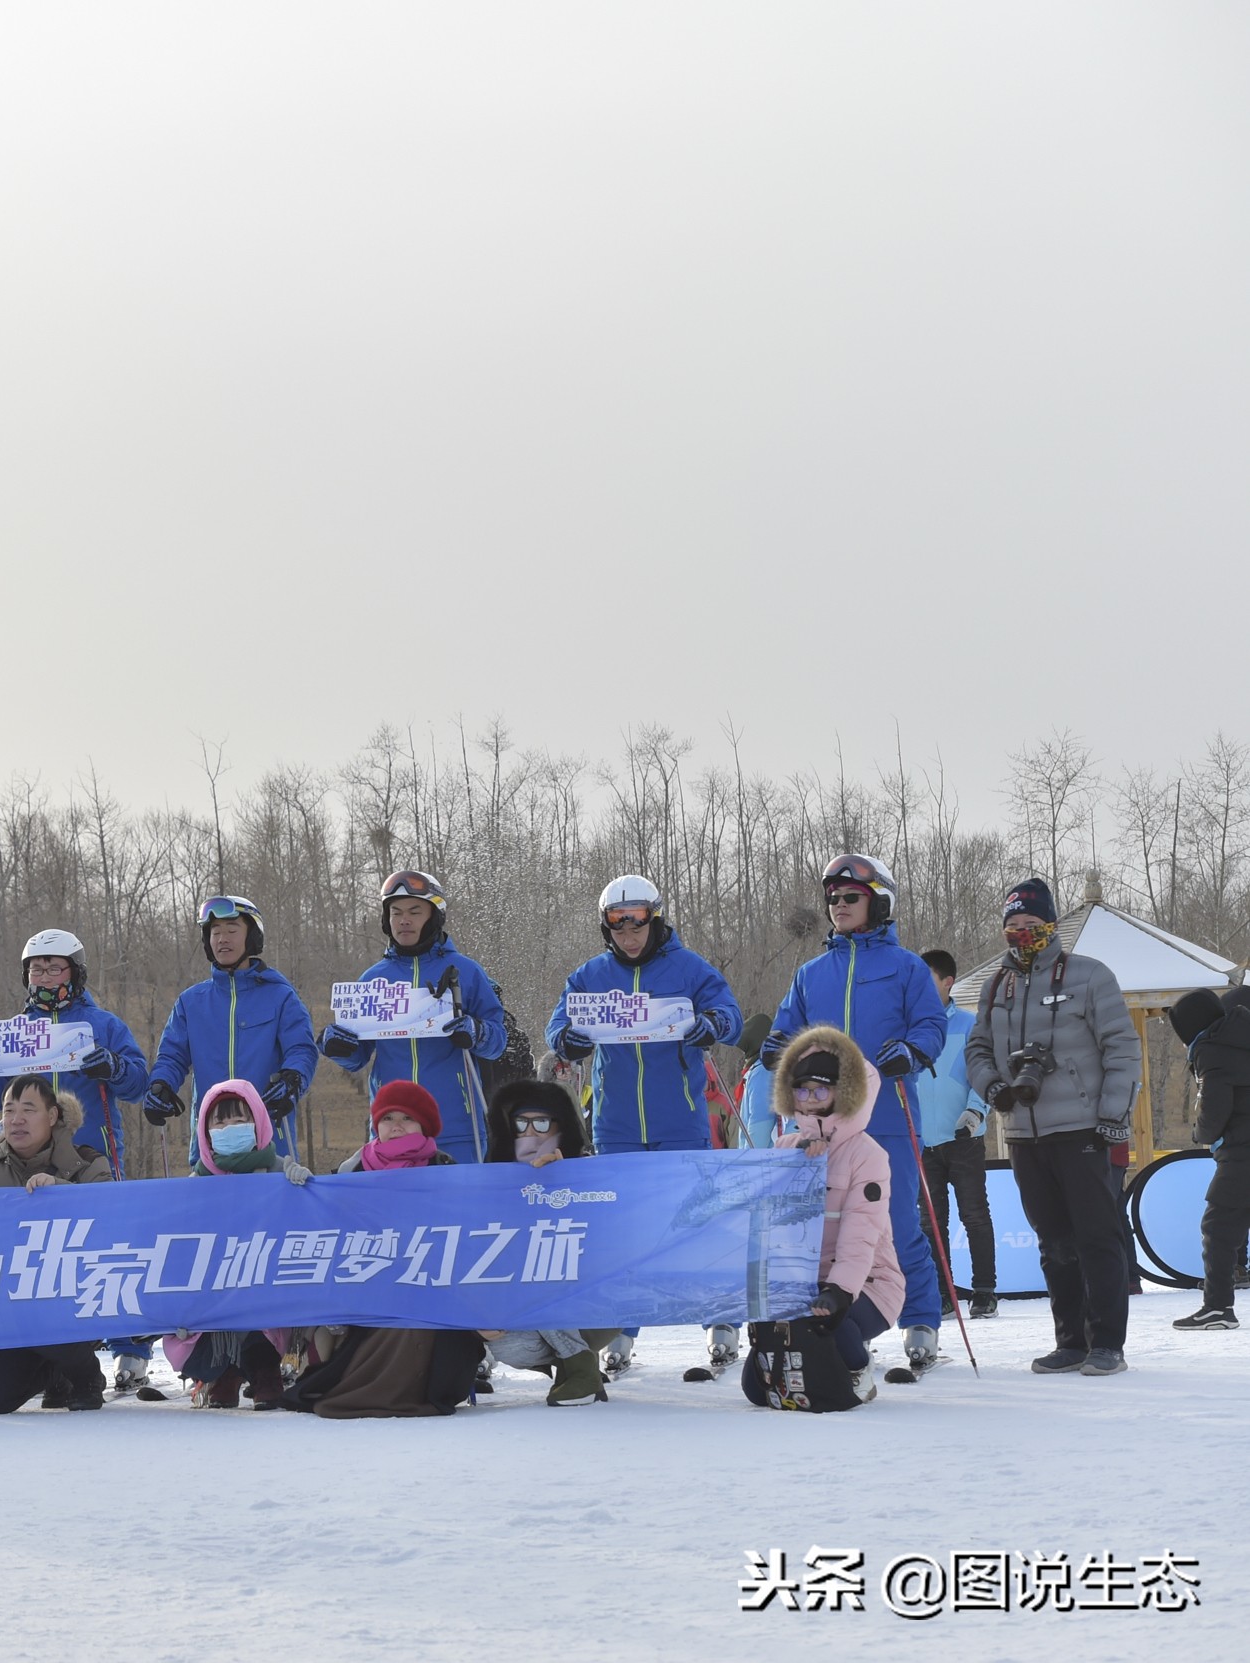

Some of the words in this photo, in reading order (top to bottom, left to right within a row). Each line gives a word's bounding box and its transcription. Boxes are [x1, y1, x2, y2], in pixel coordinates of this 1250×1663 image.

[334, 978, 409, 999] 红红火火中国年
[568, 990, 648, 1009] 红红火火中国年
[360, 995, 410, 1022] 张家口
[597, 1005, 649, 1028] 张家口
[2, 1032, 51, 1058] 张家口
[1099, 1126, 1130, 1138] COOL
